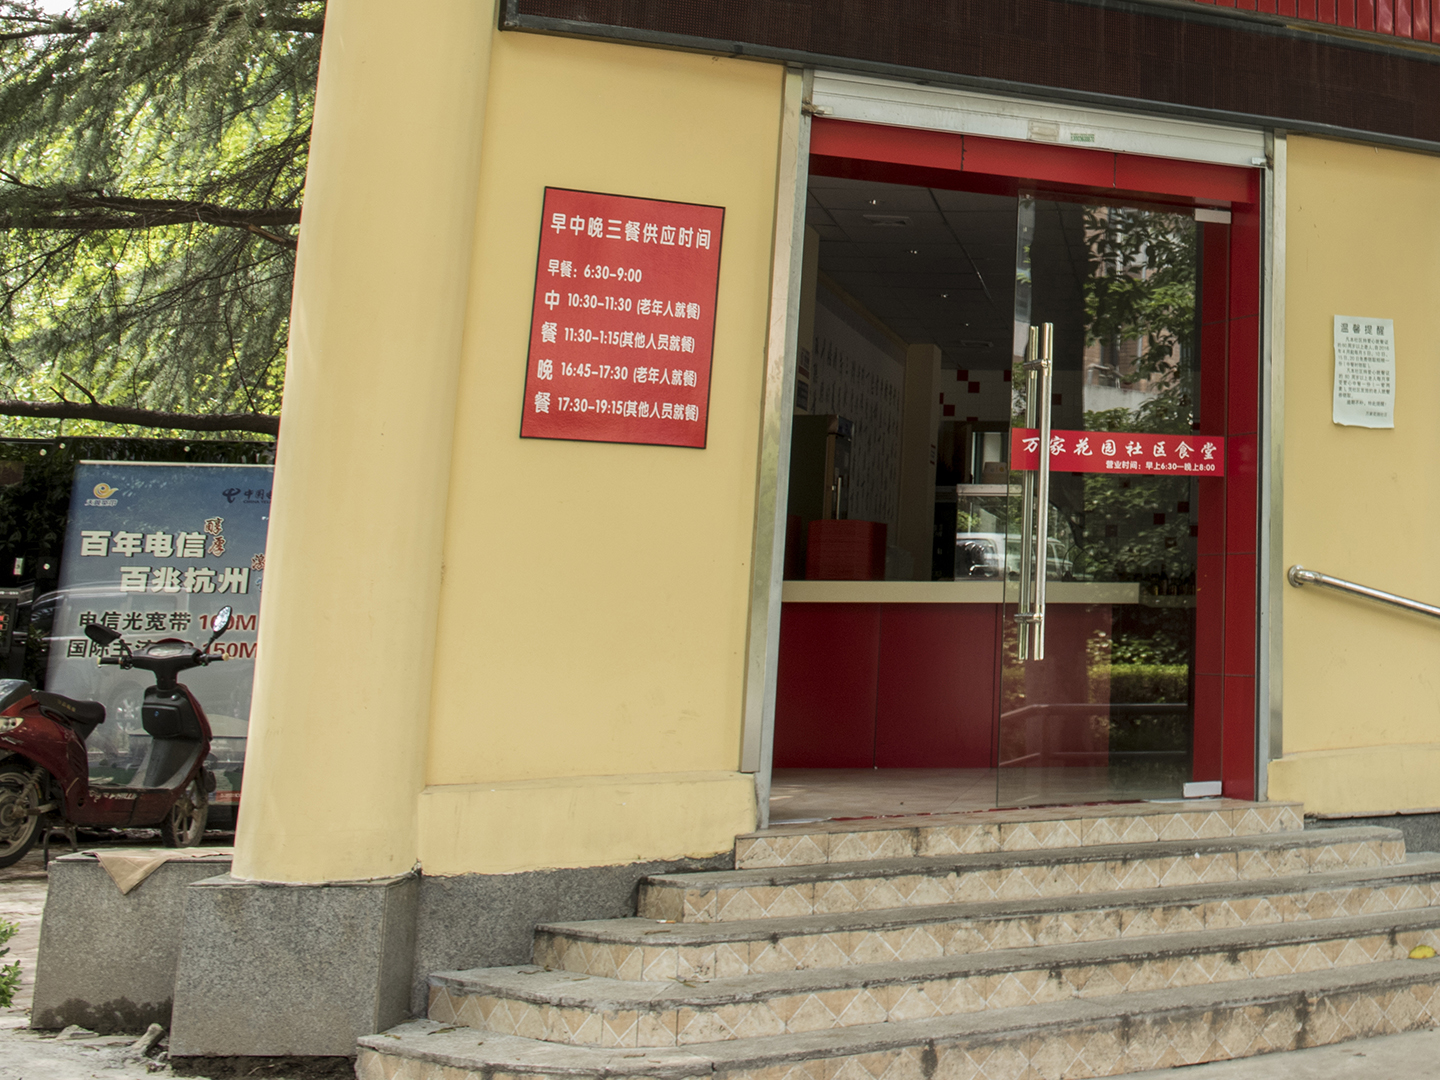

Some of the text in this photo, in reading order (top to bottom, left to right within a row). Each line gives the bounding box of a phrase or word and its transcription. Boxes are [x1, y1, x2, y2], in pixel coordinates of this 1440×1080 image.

[550, 212, 712, 250] 早中晚三餐供应时间
[544, 289, 560, 311] 中
[541, 321, 558, 344] 餐
[537, 359, 554, 381] 晚
[534, 391, 551, 414] 餐
[1021, 435, 1217, 460] 万家花园社区食堂
[80, 530, 208, 558] 百年电信
[119, 566, 250, 595] 百兆杭州
[79, 611, 192, 631] 电信光宽带
